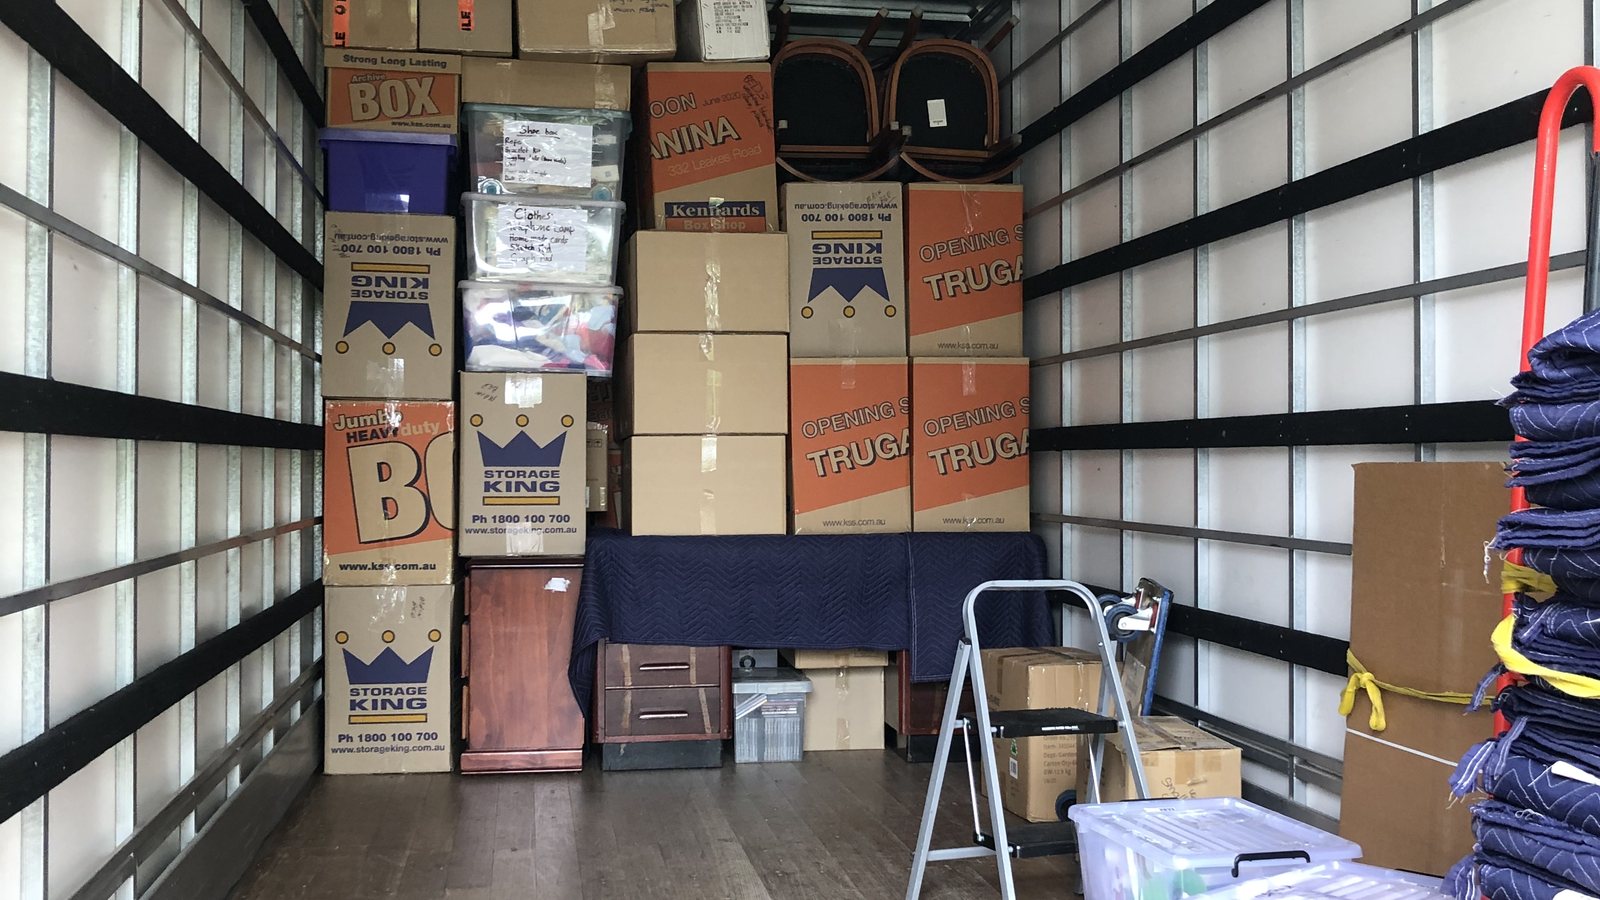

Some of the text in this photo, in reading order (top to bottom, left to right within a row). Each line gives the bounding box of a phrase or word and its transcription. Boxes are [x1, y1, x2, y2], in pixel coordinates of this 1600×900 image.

[335, 0, 347, 15] O
[343, 54, 447, 69] Strong Long Lasting
[351, 73, 386, 83] Archive
[347, 75, 441, 122] BOX
[650, 92, 697, 118] OON
[519, 125, 558, 136] Shoe box
[732, 144, 762, 160] Road
[672, 204, 760, 217] Kennards
[801, 213, 892, 222] Ph 1800 100 700
[684, 219, 747, 231] Box Shop
[341, 244, 441, 256] Ph 1800 100 700
[812, 242, 882, 255] KING
[919, 228, 1010, 263] OPENING
[812, 256, 882, 265] STORAGE
[351, 275, 429, 289] KING
[351, 290, 429, 300] STORAGE
[801, 402, 895, 439] OPENING
[923, 402, 1016, 437] OPENING
[346, 419, 440, 444] HEAVY duty
[484, 470, 560, 479] STORAGE
[484, 480, 560, 493] KING
[472, 514, 571, 523] Ph 1800 100 700
[465, 526, 577, 535] www.storagekng.com.au
[350, 687, 427, 697] STORAGE
[349, 698, 427, 711] KING
[338, 732, 438, 743] Ph 1800 100 700
[331, 744, 445, 754] www.storageking.com.au
